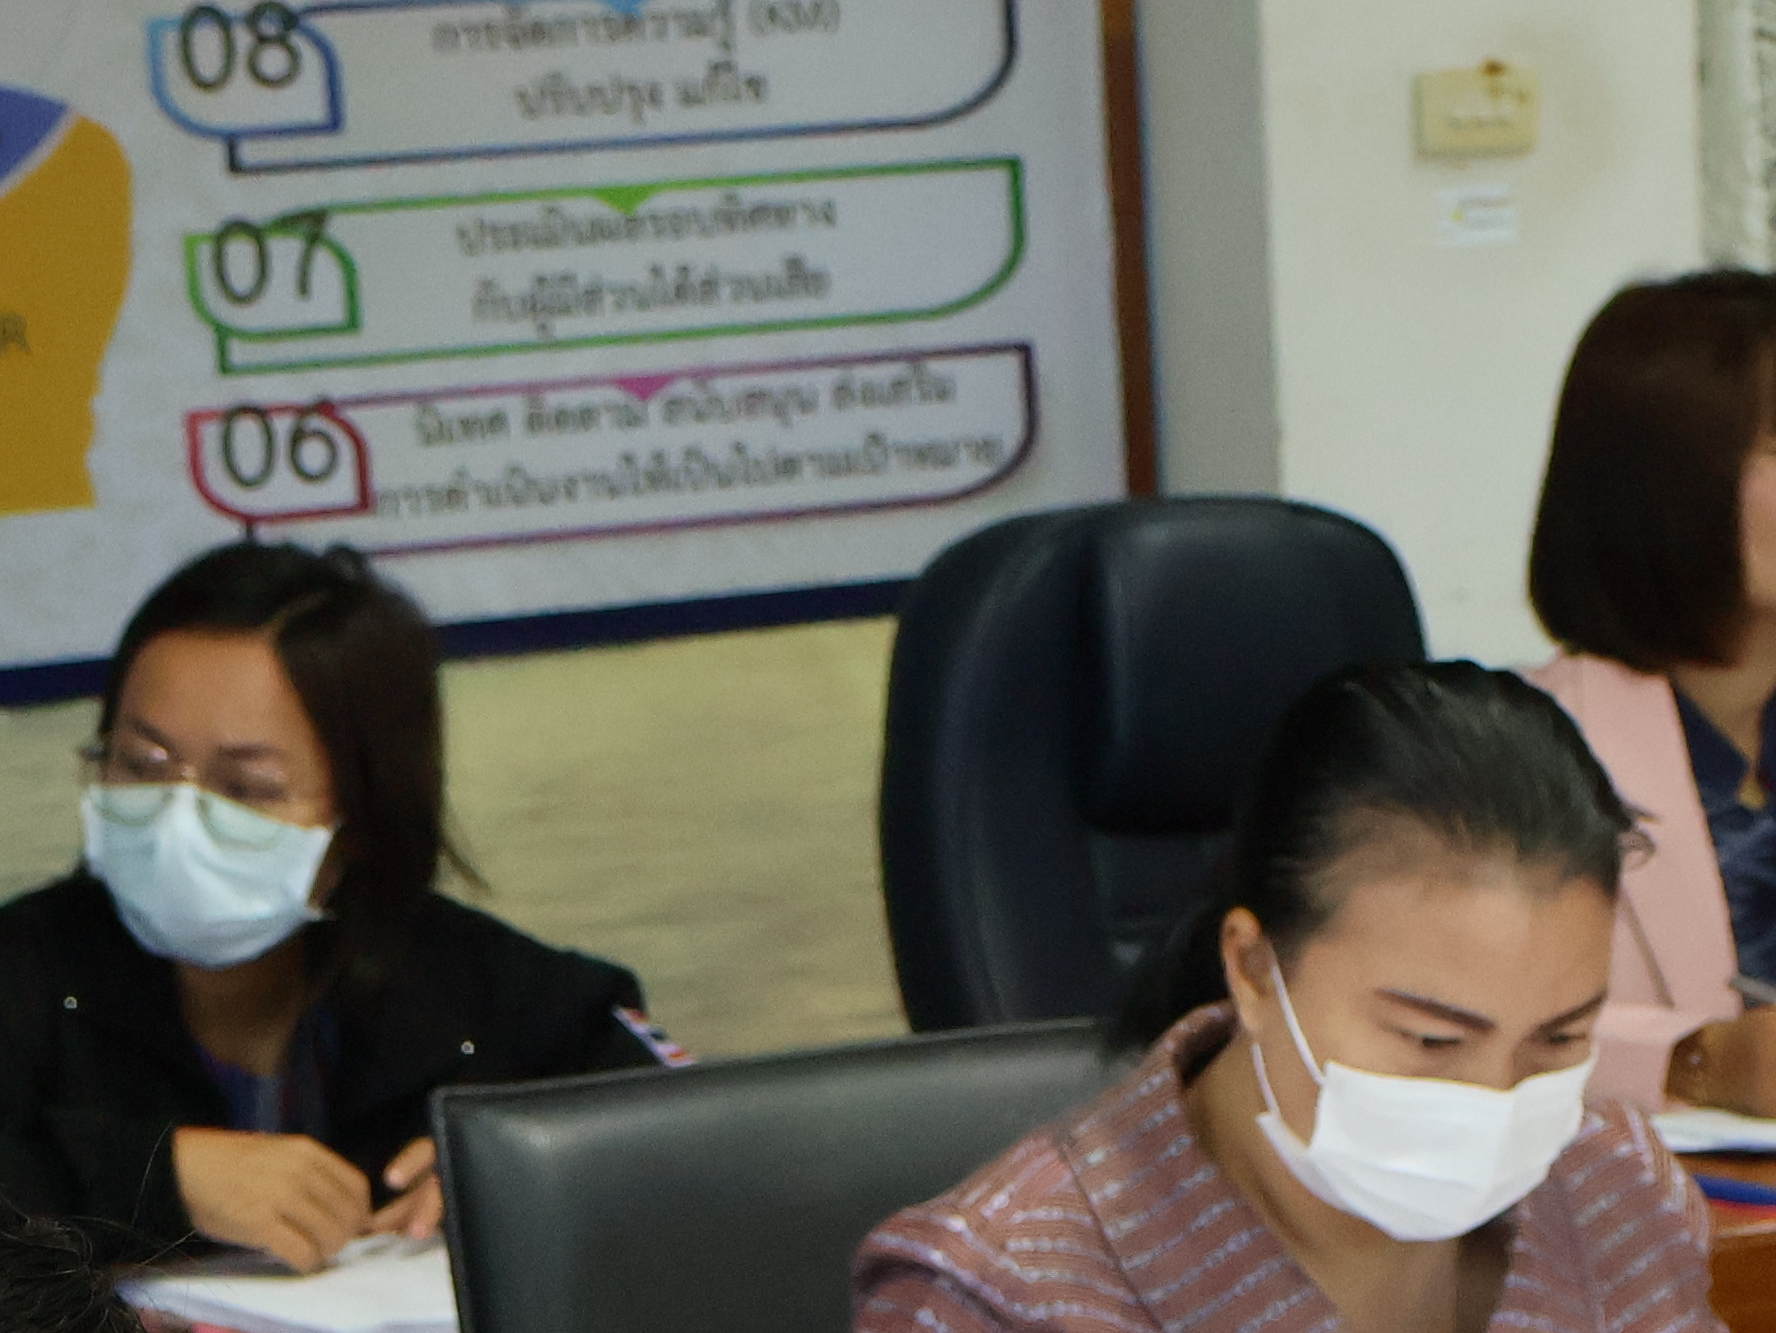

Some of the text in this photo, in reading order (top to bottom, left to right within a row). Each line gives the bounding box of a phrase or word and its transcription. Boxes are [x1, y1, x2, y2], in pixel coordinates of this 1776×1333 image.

[181, 0, 300, 92] 08
[211, 208, 332, 306] 07
[220, 398, 340, 492] 06
